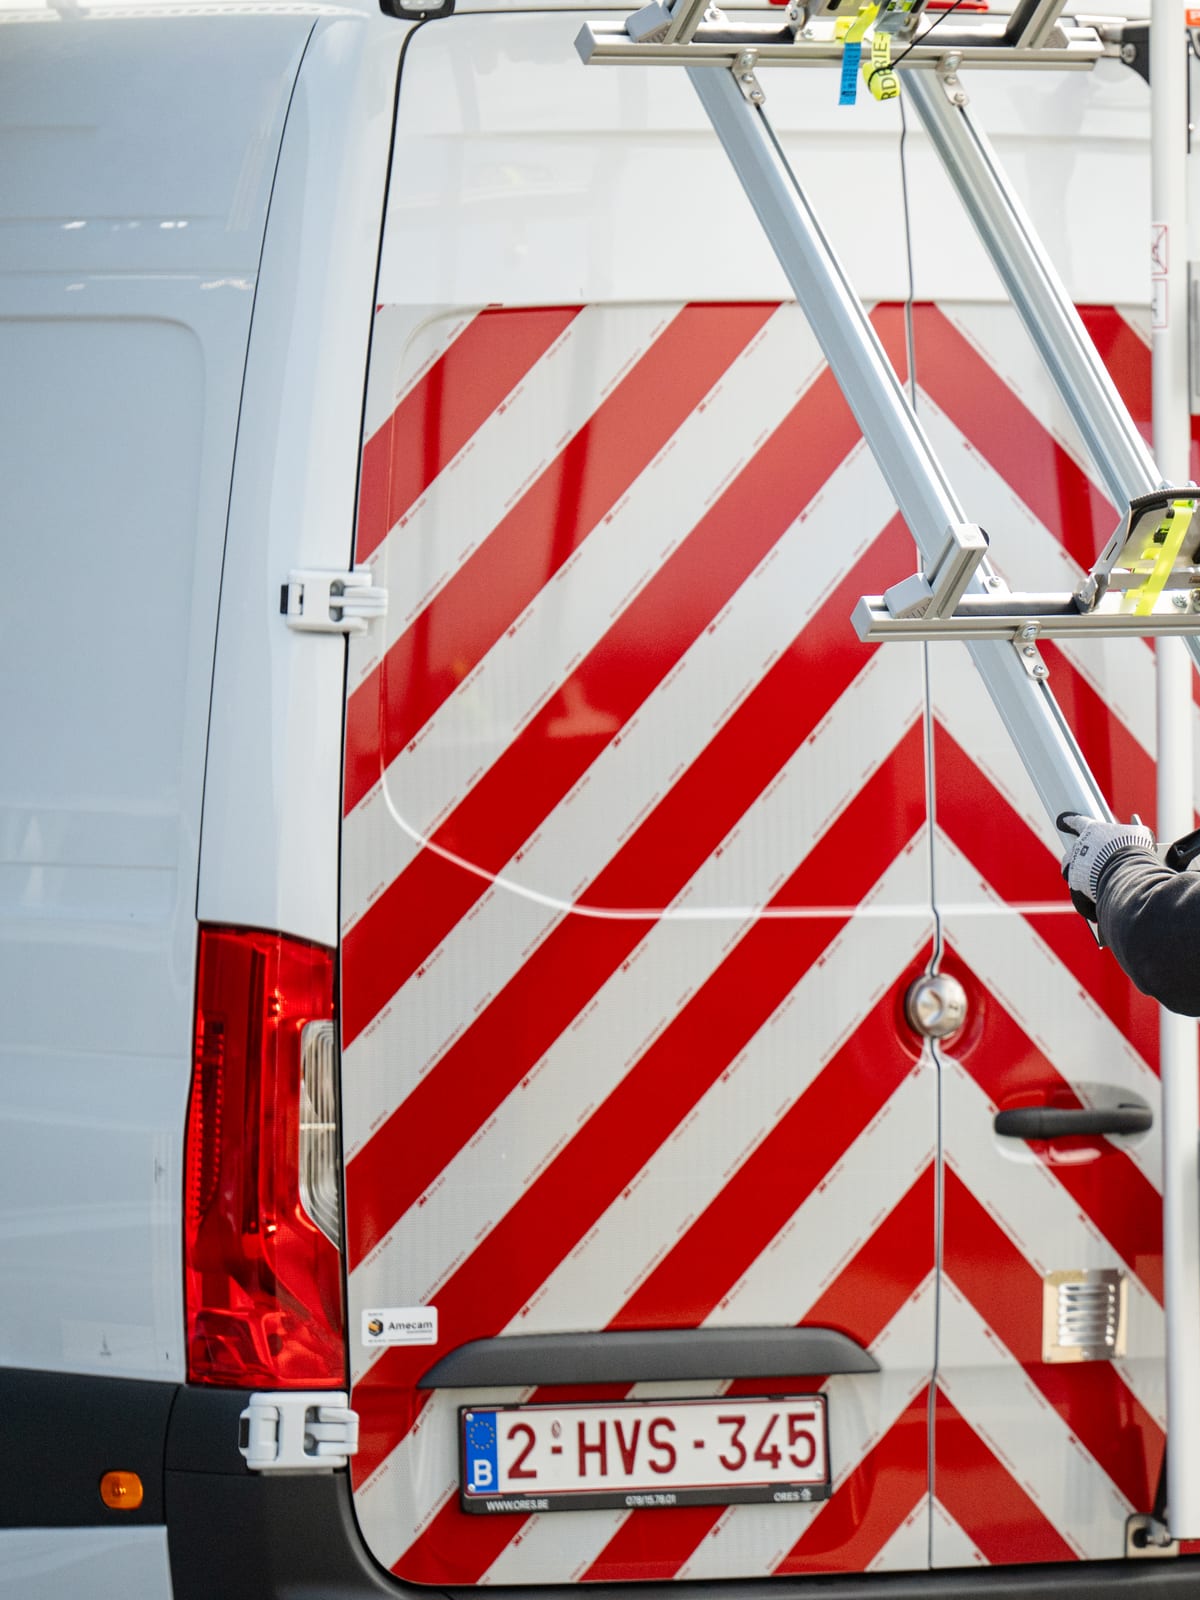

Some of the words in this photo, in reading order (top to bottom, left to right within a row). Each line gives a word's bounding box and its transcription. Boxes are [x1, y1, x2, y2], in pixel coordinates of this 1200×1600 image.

[388, 1321, 433, 1330] Amecam
[473, 1459, 492, 1486] B
[774, 1491, 799, 1502] ORES
